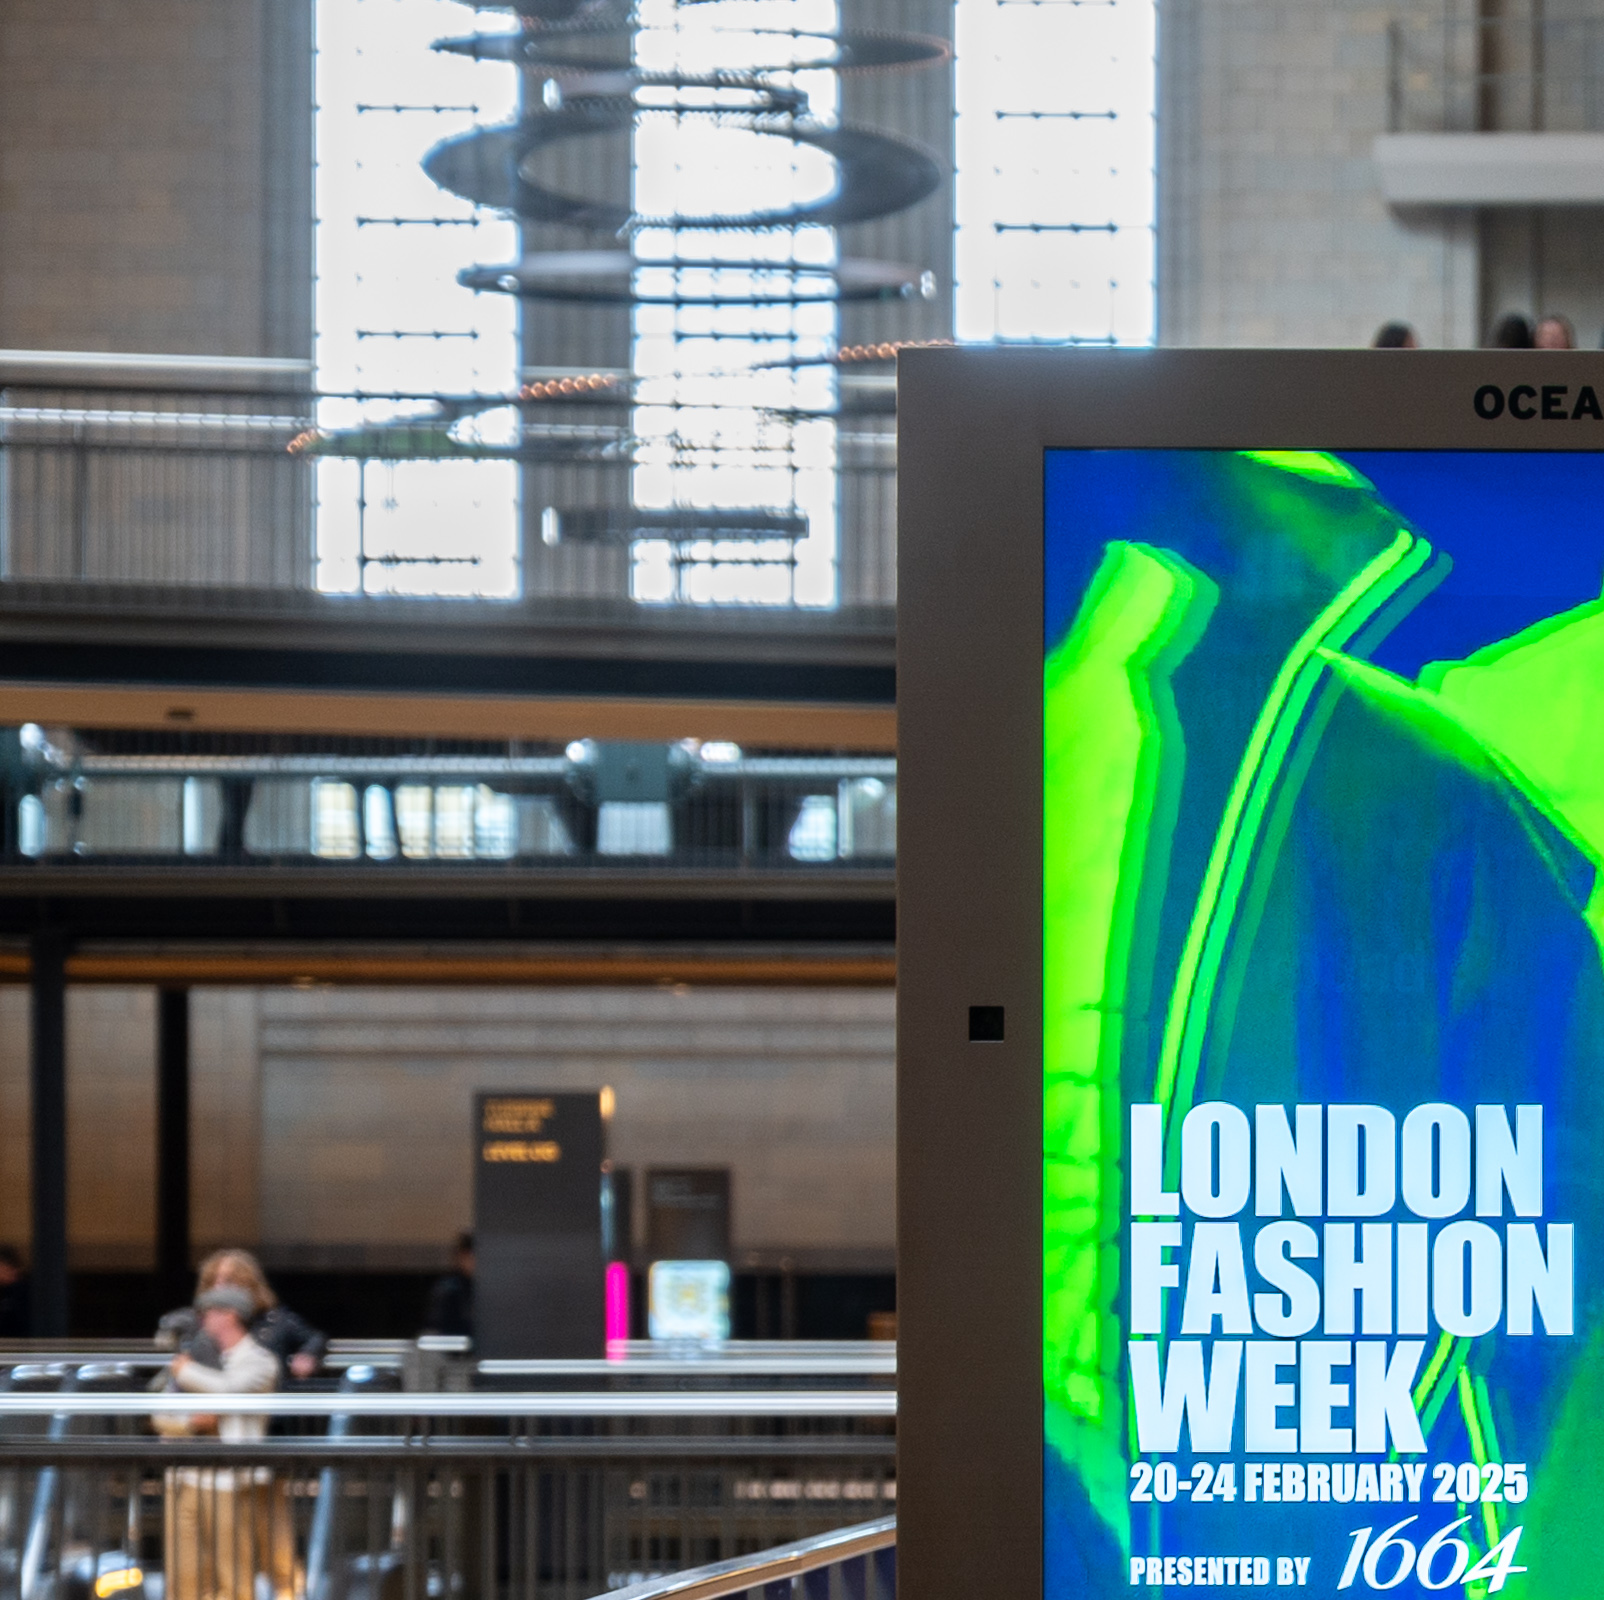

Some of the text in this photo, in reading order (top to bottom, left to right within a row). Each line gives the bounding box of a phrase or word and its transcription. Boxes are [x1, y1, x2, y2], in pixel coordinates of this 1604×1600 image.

[1130, 1102, 1543, 1218] LONDON
[1130, 1221, 1574, 1336] FASHION
[1128, 1341, 1428, 1453] WEEK
[1129, 1462, 1528, 1504] 20-24 FEBRUARY 2025
[1129, 1515, 1528, 1594] PRESENTED BY 1664
